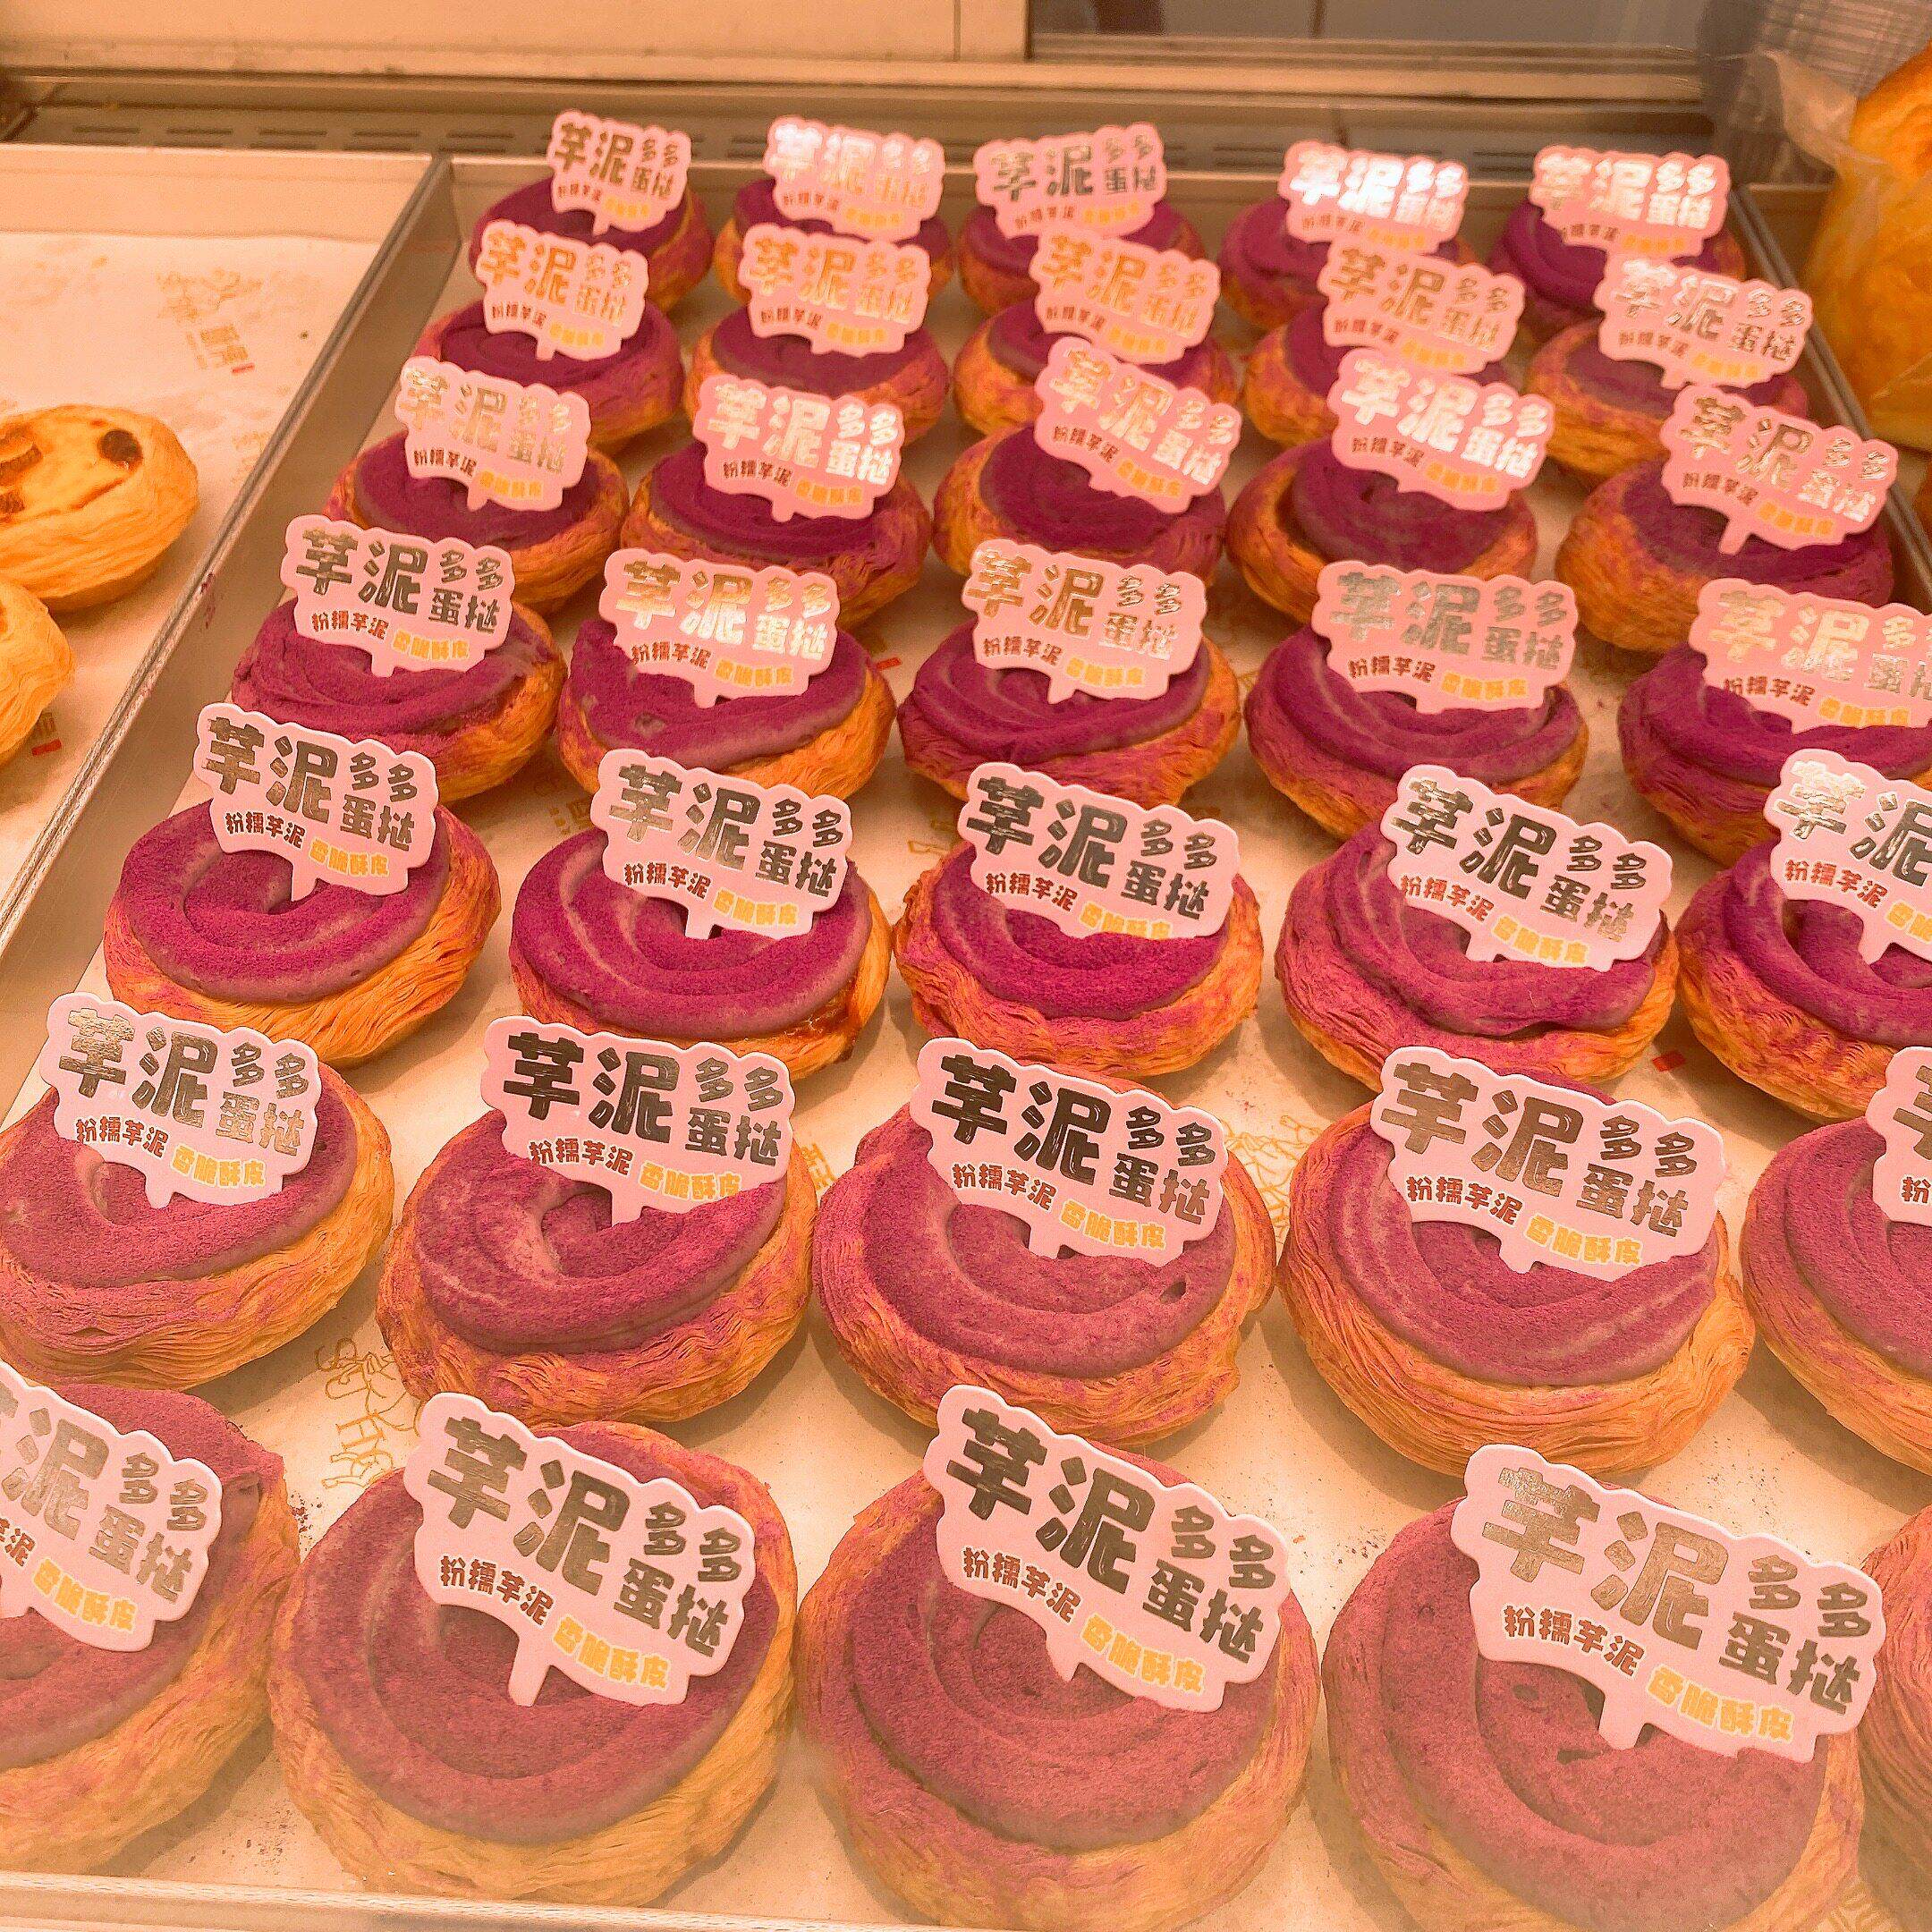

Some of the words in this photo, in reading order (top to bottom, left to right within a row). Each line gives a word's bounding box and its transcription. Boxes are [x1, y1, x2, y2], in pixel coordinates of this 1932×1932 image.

[555, 123, 635, 187] 芋泥
[710, 385, 830, 466] 芋泥
[1343, 360, 1477, 452] 芋泥
[297, 528, 429, 614] 芋泥
[440, 550, 504, 591] 多多
[617, 561, 755, 644] 芋泥
[765, 576, 832, 619] 多多
[966, 548, 1105, 640] 芋泥
[1117, 575, 1181, 615] 多多
[428, 588, 500, 633] 蛋挞
[1330, 572, 1482, 656] 芋泥
[1494, 586, 1567, 626] 多多
[1882, 615, 1932, 660] 多
[204, 716, 338, 824] 芋泥
[350, 752, 417, 802] 多多
[225, 811, 305, 849] 粉糯芋泥
[342, 794, 414, 850] 蛋挞
[610, 764, 761, 871] 芋泥
[773, 799, 843, 847] 多多
[969, 776, 1128, 888] 芋泥
[1141, 819, 1216, 870] 多多
[1394, 778, 1557, 901] 芋泥
[1775, 760, 1932, 888] 芋泥
[624, 862, 711, 899] 粉糯芋泥
[756, 841, 836, 897] 蛋挞
[983, 873, 1077, 911] 粉糯芋泥
[1123, 860, 1209, 919] 蛋挞
[1566, 836, 1647, 889] 多多
[1397, 876, 1494, 921] 粉糯芋泥
[1542, 874, 1635, 942] 蛋挞
[60, 1009, 219, 1126] 芋泥
[231, 1042, 309, 1094] 多多
[504, 1033, 681, 1143] 芋泥
[695, 1057, 783, 1112] 多多
[74, 1116, 168, 1157] 粉糯芋泥
[216, 1091, 302, 1154] 蛋挞
[685, 1107, 780, 1165] 蛋挞
[933, 1055, 1113, 1184] 芋泥
[1126, 1106, 1216, 1166] 多多
[1384, 1062, 1584, 1197] 芋泥
[1600, 1115, 1697, 1176] 多多
[173, 1146, 264, 1186] 香脆酥皮
[526, 1139, 633, 1177] 粉糯芋泥
[953, 1164, 1056, 1210] 粉糯芋泥
[1110, 1153, 1208, 1223] 蛋挞
[1406, 1176, 1522, 1224] 粉糯芋泥
[1580, 1164, 1688, 1235] 蛋挞
[1527, 1216, 1640, 1264] 香脆酥皮
[119, 1453, 207, 1530] 多多
[428, 1418, 631, 1596] 芋泥
[947, 1410, 1156, 1595] 芋泥
[90, 1506, 192, 1602] 蛋挞
[644, 1502, 741, 1581] 多多
[1171, 1505, 1275, 1589] 多多
[1484, 1469, 1730, 1648] 芋泥
[441, 1555, 554, 1625] 粉糯芋泥
[614, 1558, 728, 1657] 蛋挞
[963, 1547, 1080, 1623] 粉糯芋泥
[1144, 1560, 1262, 1664] 蛋挞
[1748, 1555, 1871, 1638] 多多
[1504, 1606, 1644, 1676] 粉糯芋泥
[1720, 1612, 1859, 1712] 蛋挞
